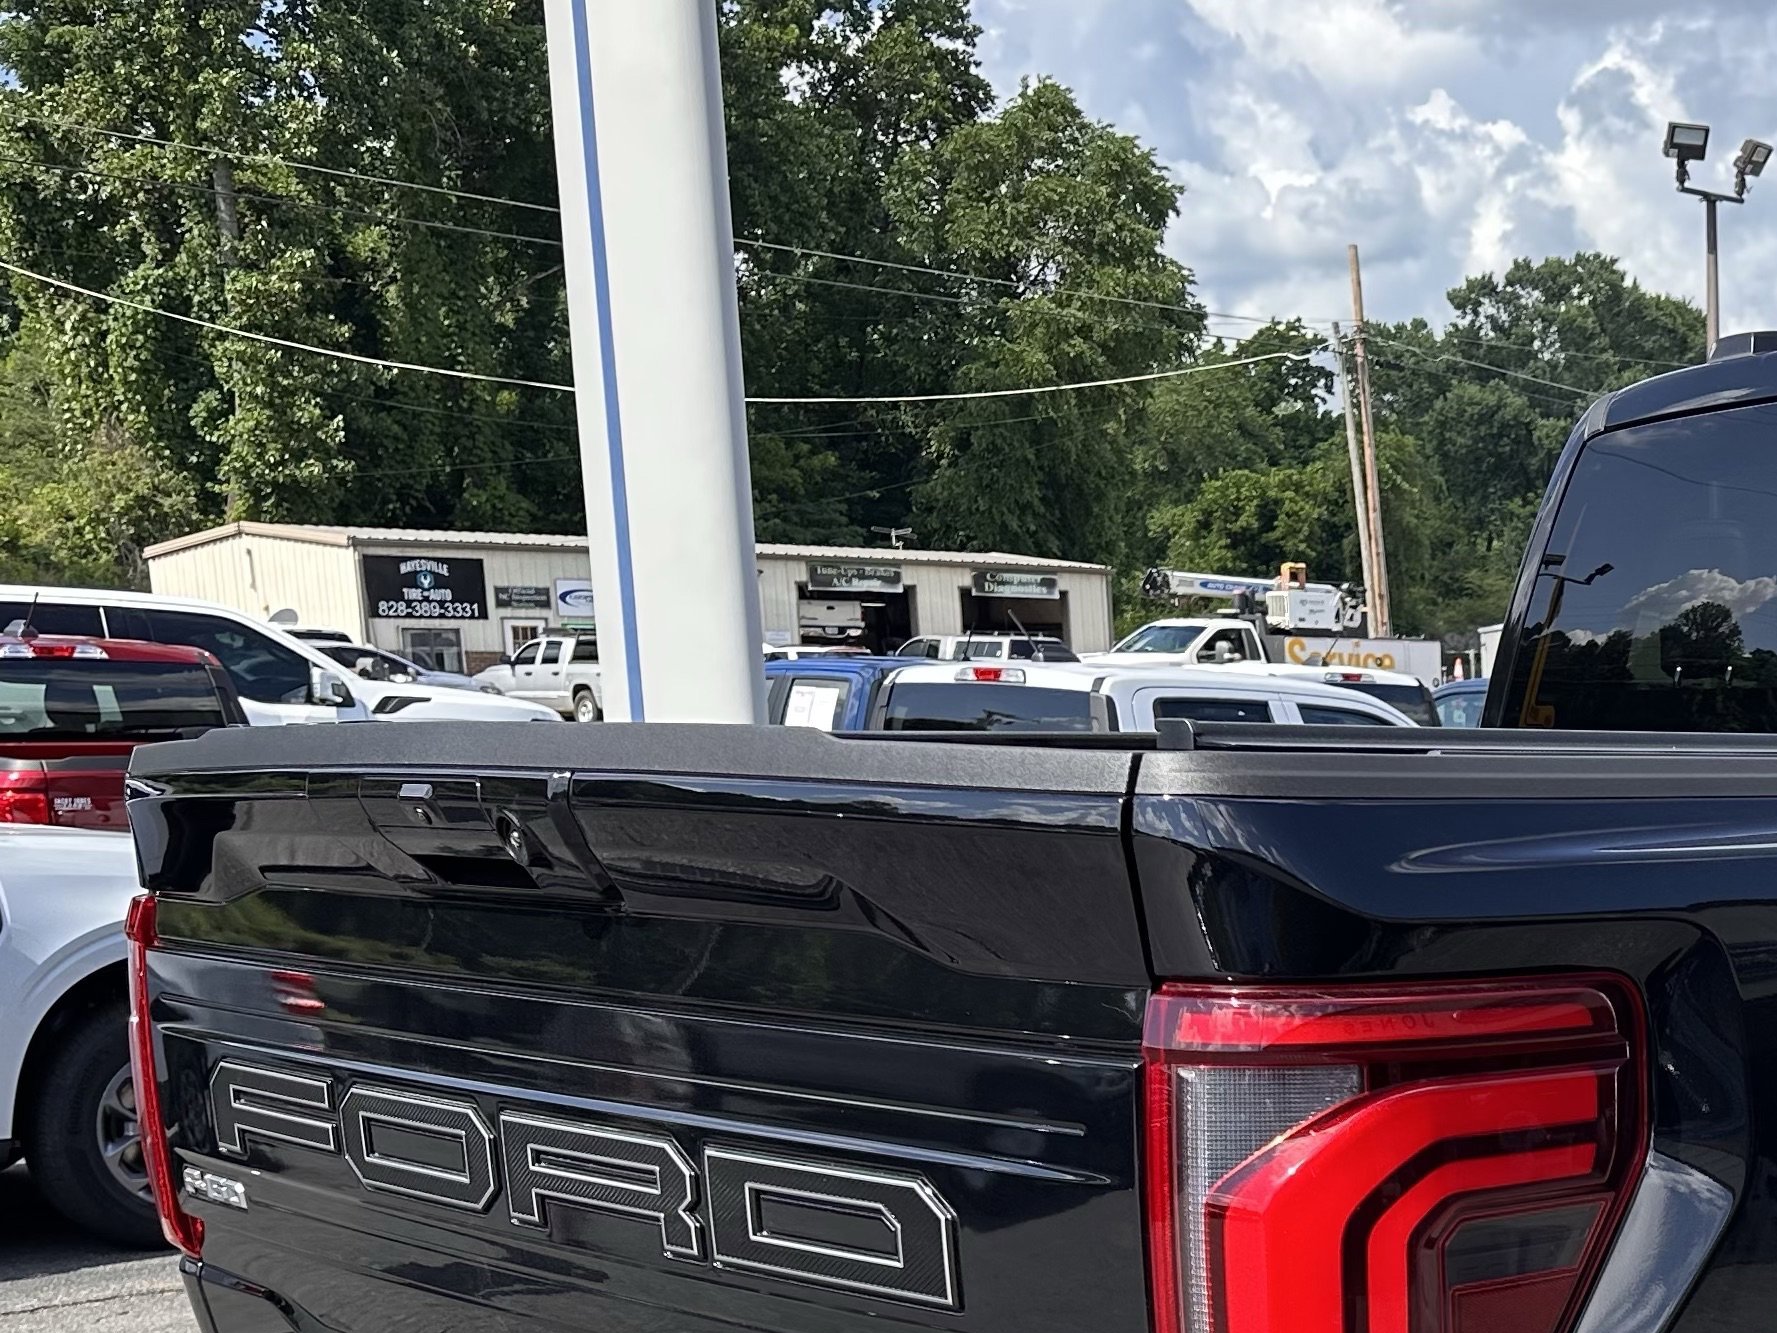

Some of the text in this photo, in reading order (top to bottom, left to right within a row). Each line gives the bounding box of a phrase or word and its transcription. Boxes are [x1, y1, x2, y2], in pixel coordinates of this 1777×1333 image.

[399, 559, 450, 577] HAYESVILLE
[402, 587, 423, 600] TIRE
[429, 588, 453, 601] AUTO
[378, 600, 479, 618] 828-389-3331
[209, 1057, 964, 1310] FORD
